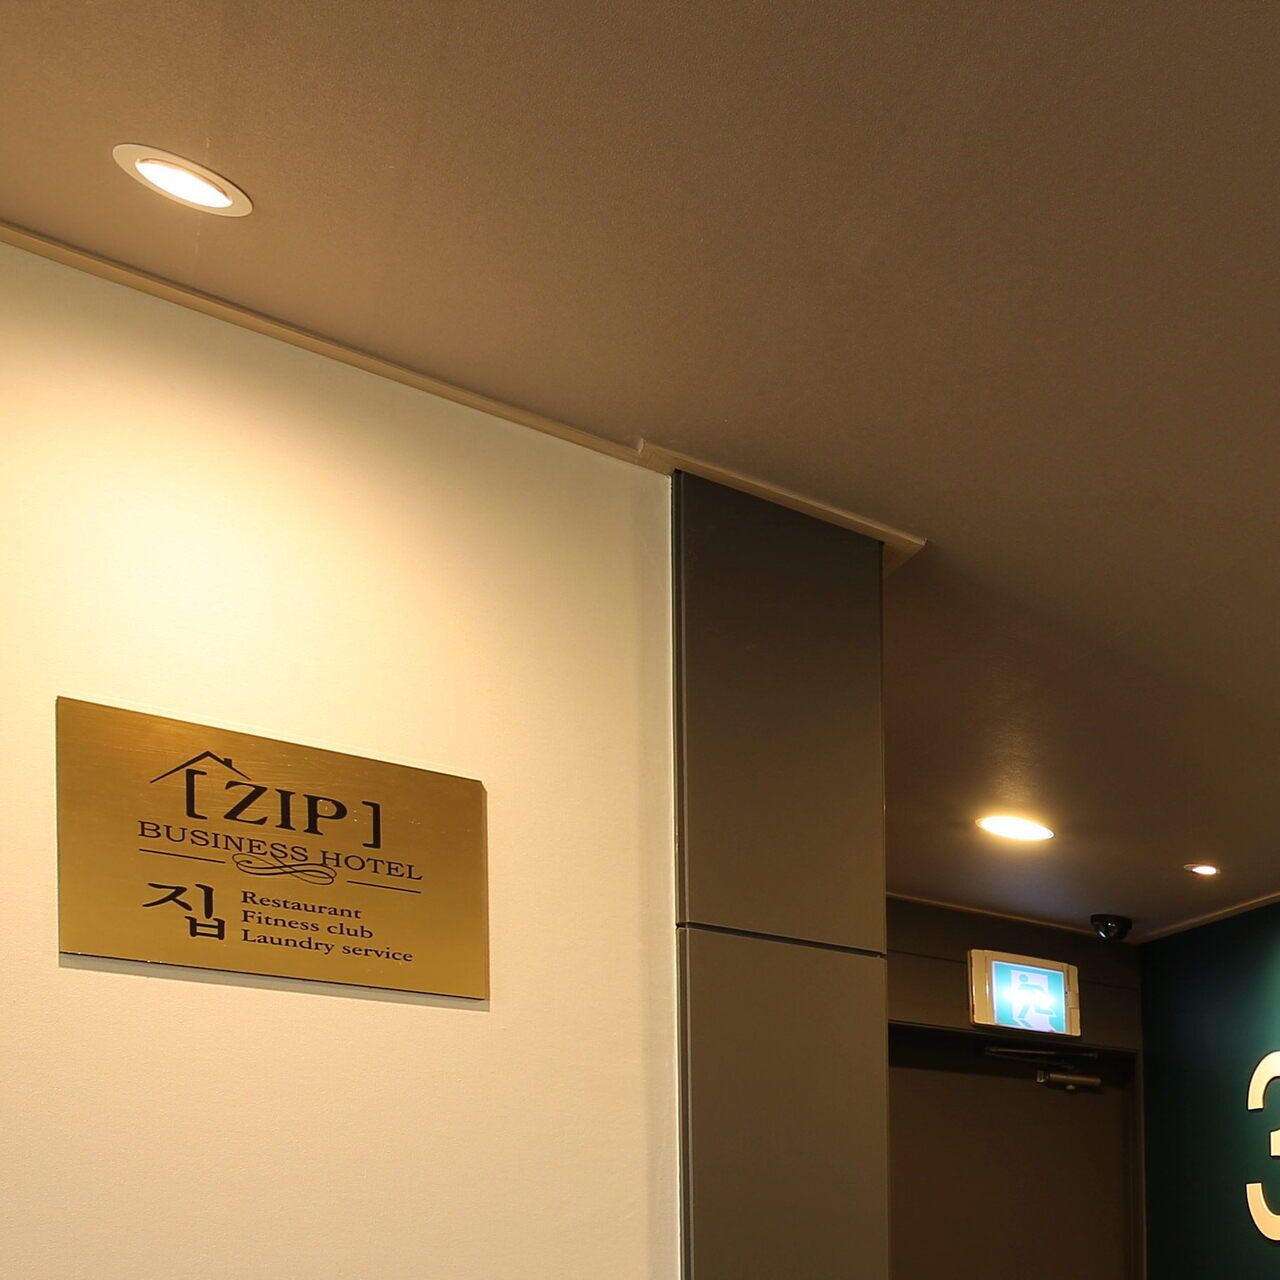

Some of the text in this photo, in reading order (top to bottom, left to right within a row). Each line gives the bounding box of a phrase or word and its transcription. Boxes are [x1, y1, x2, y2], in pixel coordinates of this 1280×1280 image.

[138, 820, 424, 882] BUSINESS HOTEL
[142, 882, 225, 941] 집
[240, 890, 363, 920] Restaurant
[240, 909, 374, 940] Fitness club
[241, 928, 414, 963] Laundry service
